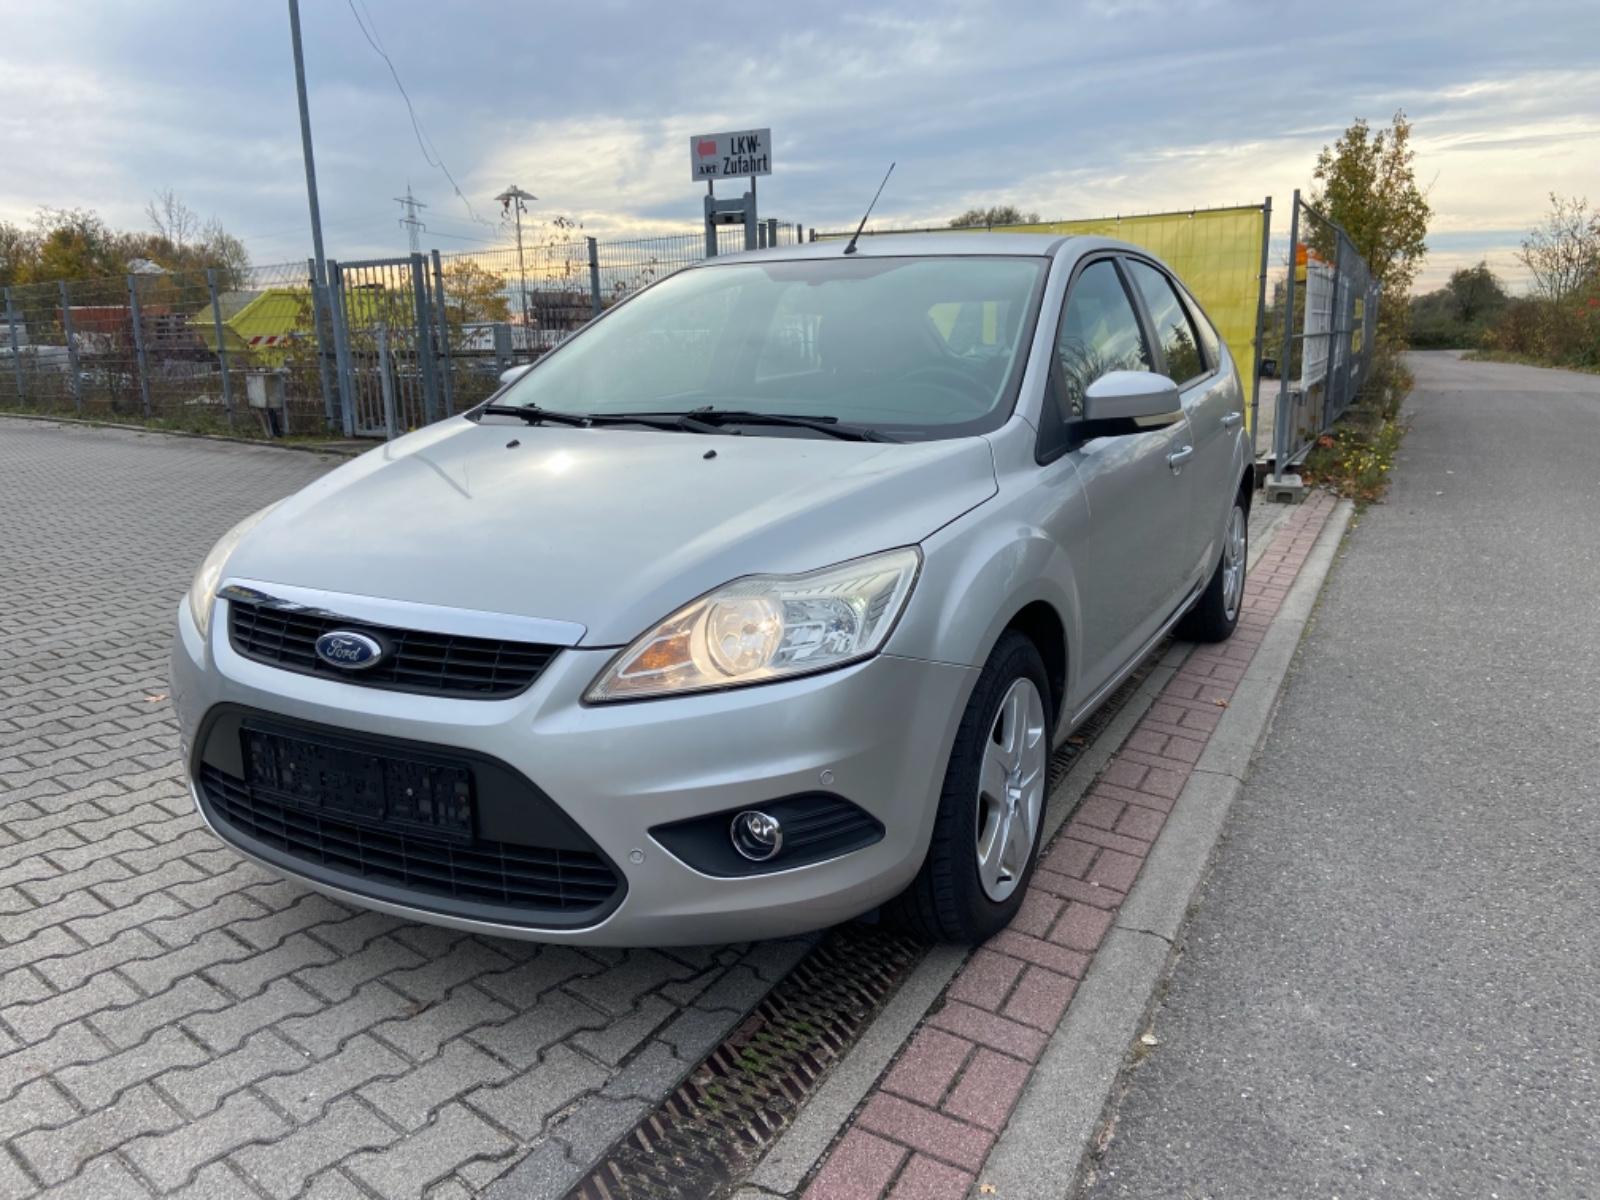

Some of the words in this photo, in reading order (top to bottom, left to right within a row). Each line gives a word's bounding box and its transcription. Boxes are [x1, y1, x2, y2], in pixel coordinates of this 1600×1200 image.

[731, 135, 761, 155] LKW-
[723, 153, 767, 175] Zufahrt
[326, 639, 361, 661] Ford
